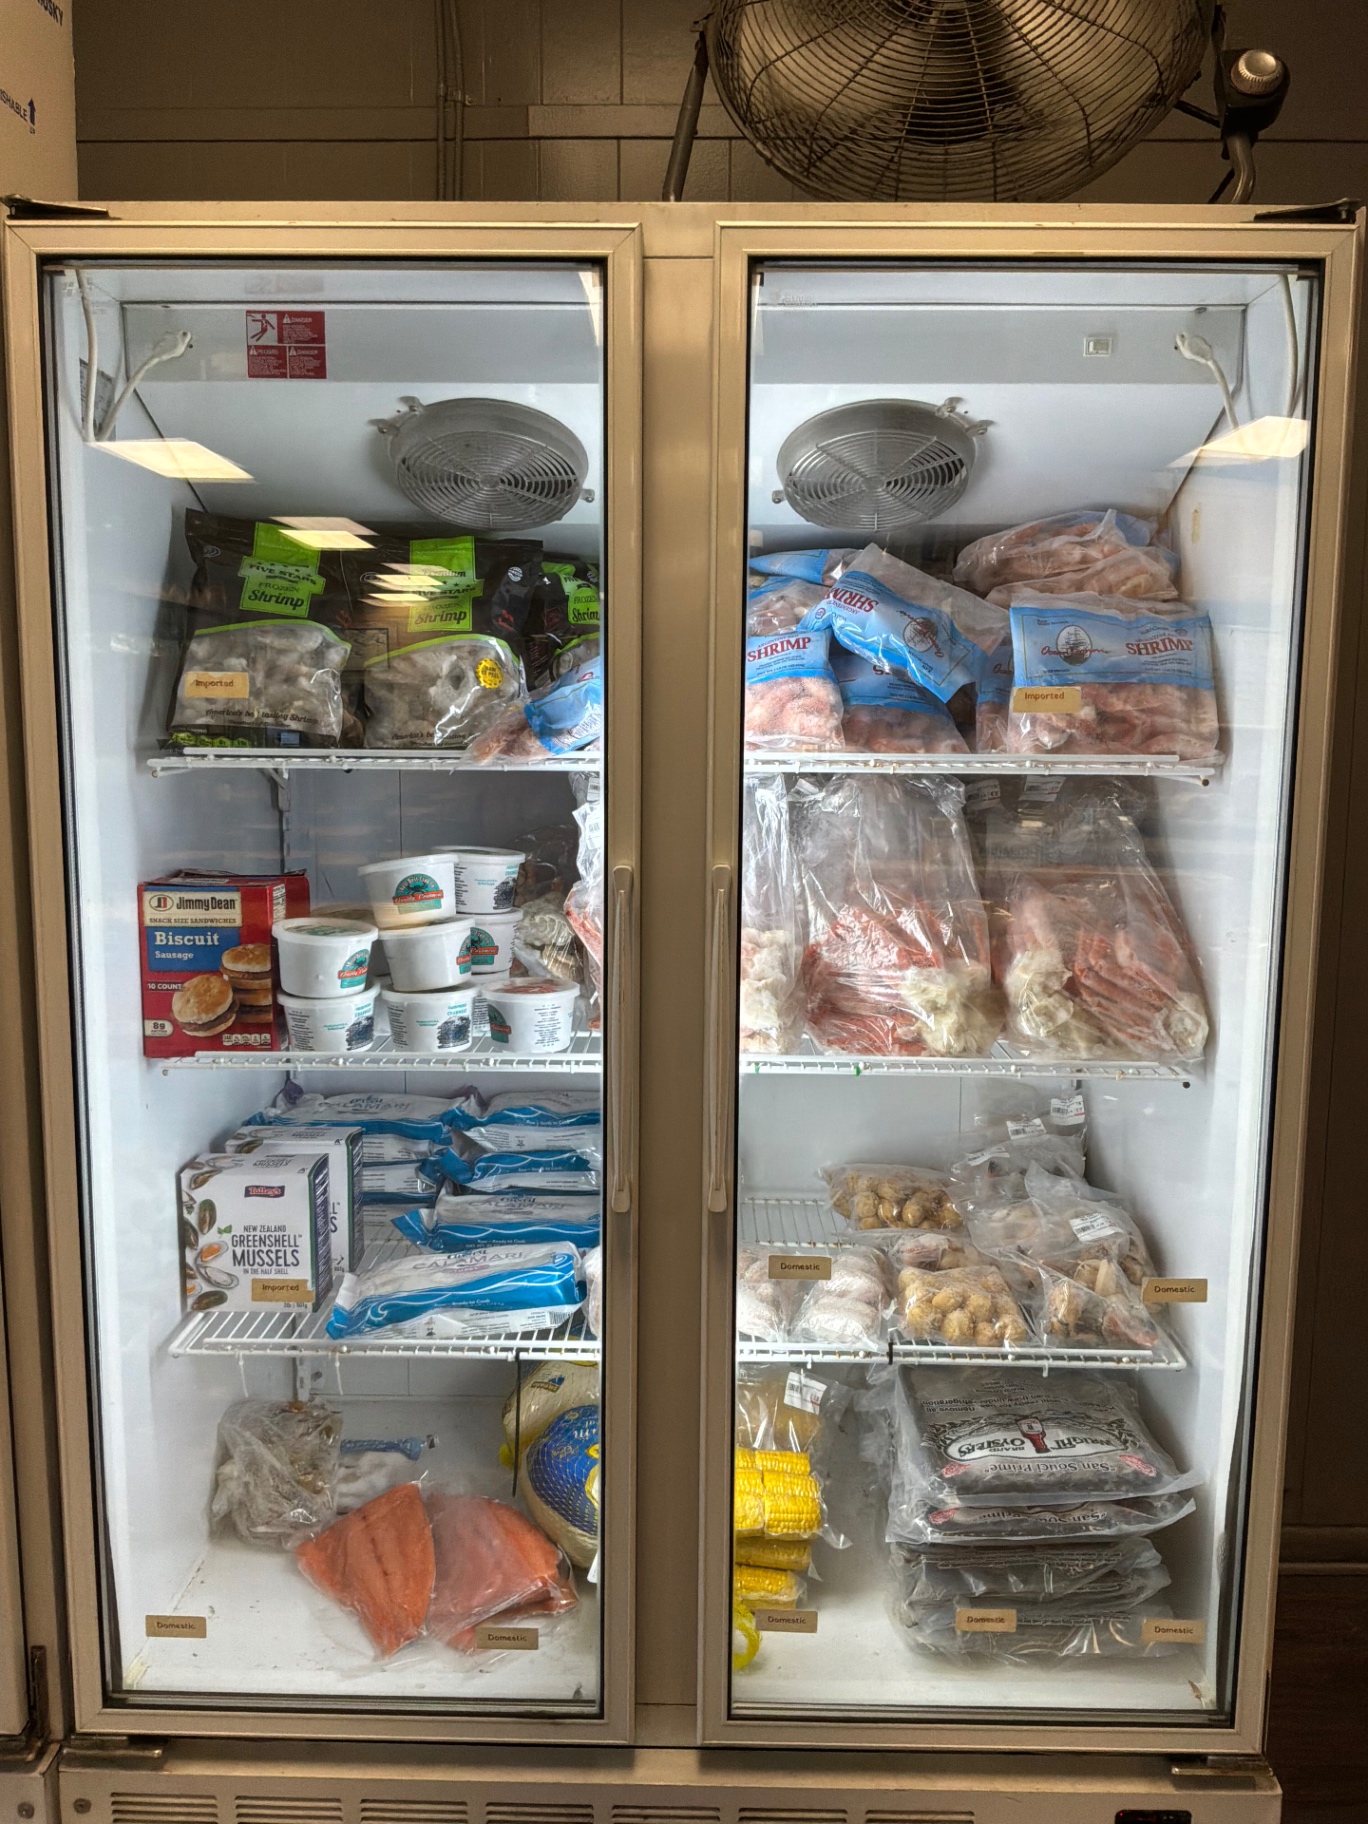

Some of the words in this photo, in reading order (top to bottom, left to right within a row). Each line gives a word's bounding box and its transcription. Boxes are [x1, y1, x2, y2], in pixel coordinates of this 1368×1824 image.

[249, 563, 276, 574] FIVE
[279, 570, 317, 586] STARS
[259, 582, 300, 593] FROZEN
[247, 589, 305, 611] Shrimp
[414, 610, 467, 625] Shrimp
[746, 636, 812, 663] SHRIMP
[1125, 636, 1194, 656] SHRIMP
[194, 679, 235, 688] Imported
[1024, 691, 1065, 700] Imported
[176, 896, 211, 911] Jimmy
[210, 896, 237, 910] Dean
[149, 917, 173, 925] SNACK
[154, 931, 220, 946] Biscuit
[155, 950, 195, 960] Sausage
[243, 1224, 258, 1233] NEW
[259, 1224, 287, 1233] ZEALAND
[232, 1249, 300, 1267] MUSSELS
[412, 1251, 523, 1270] CALAMARI
[780, 1261, 821, 1272] Domestic
[262, 1283, 300, 1292] Imported
[1154, 1284, 1196, 1295] Domestic
[957, 1437, 1026, 1458] OYSTERS
[1036, 1462, 1079, 1473] Souci
[768, 1615, 807, 1625] Domestic
[966, 1614, 1007, 1625] Domestic
[156, 1621, 196, 1630] Domestic
[1153, 1624, 1195, 1635] Domestic
[487, 1633, 528, 1643] Domestic
